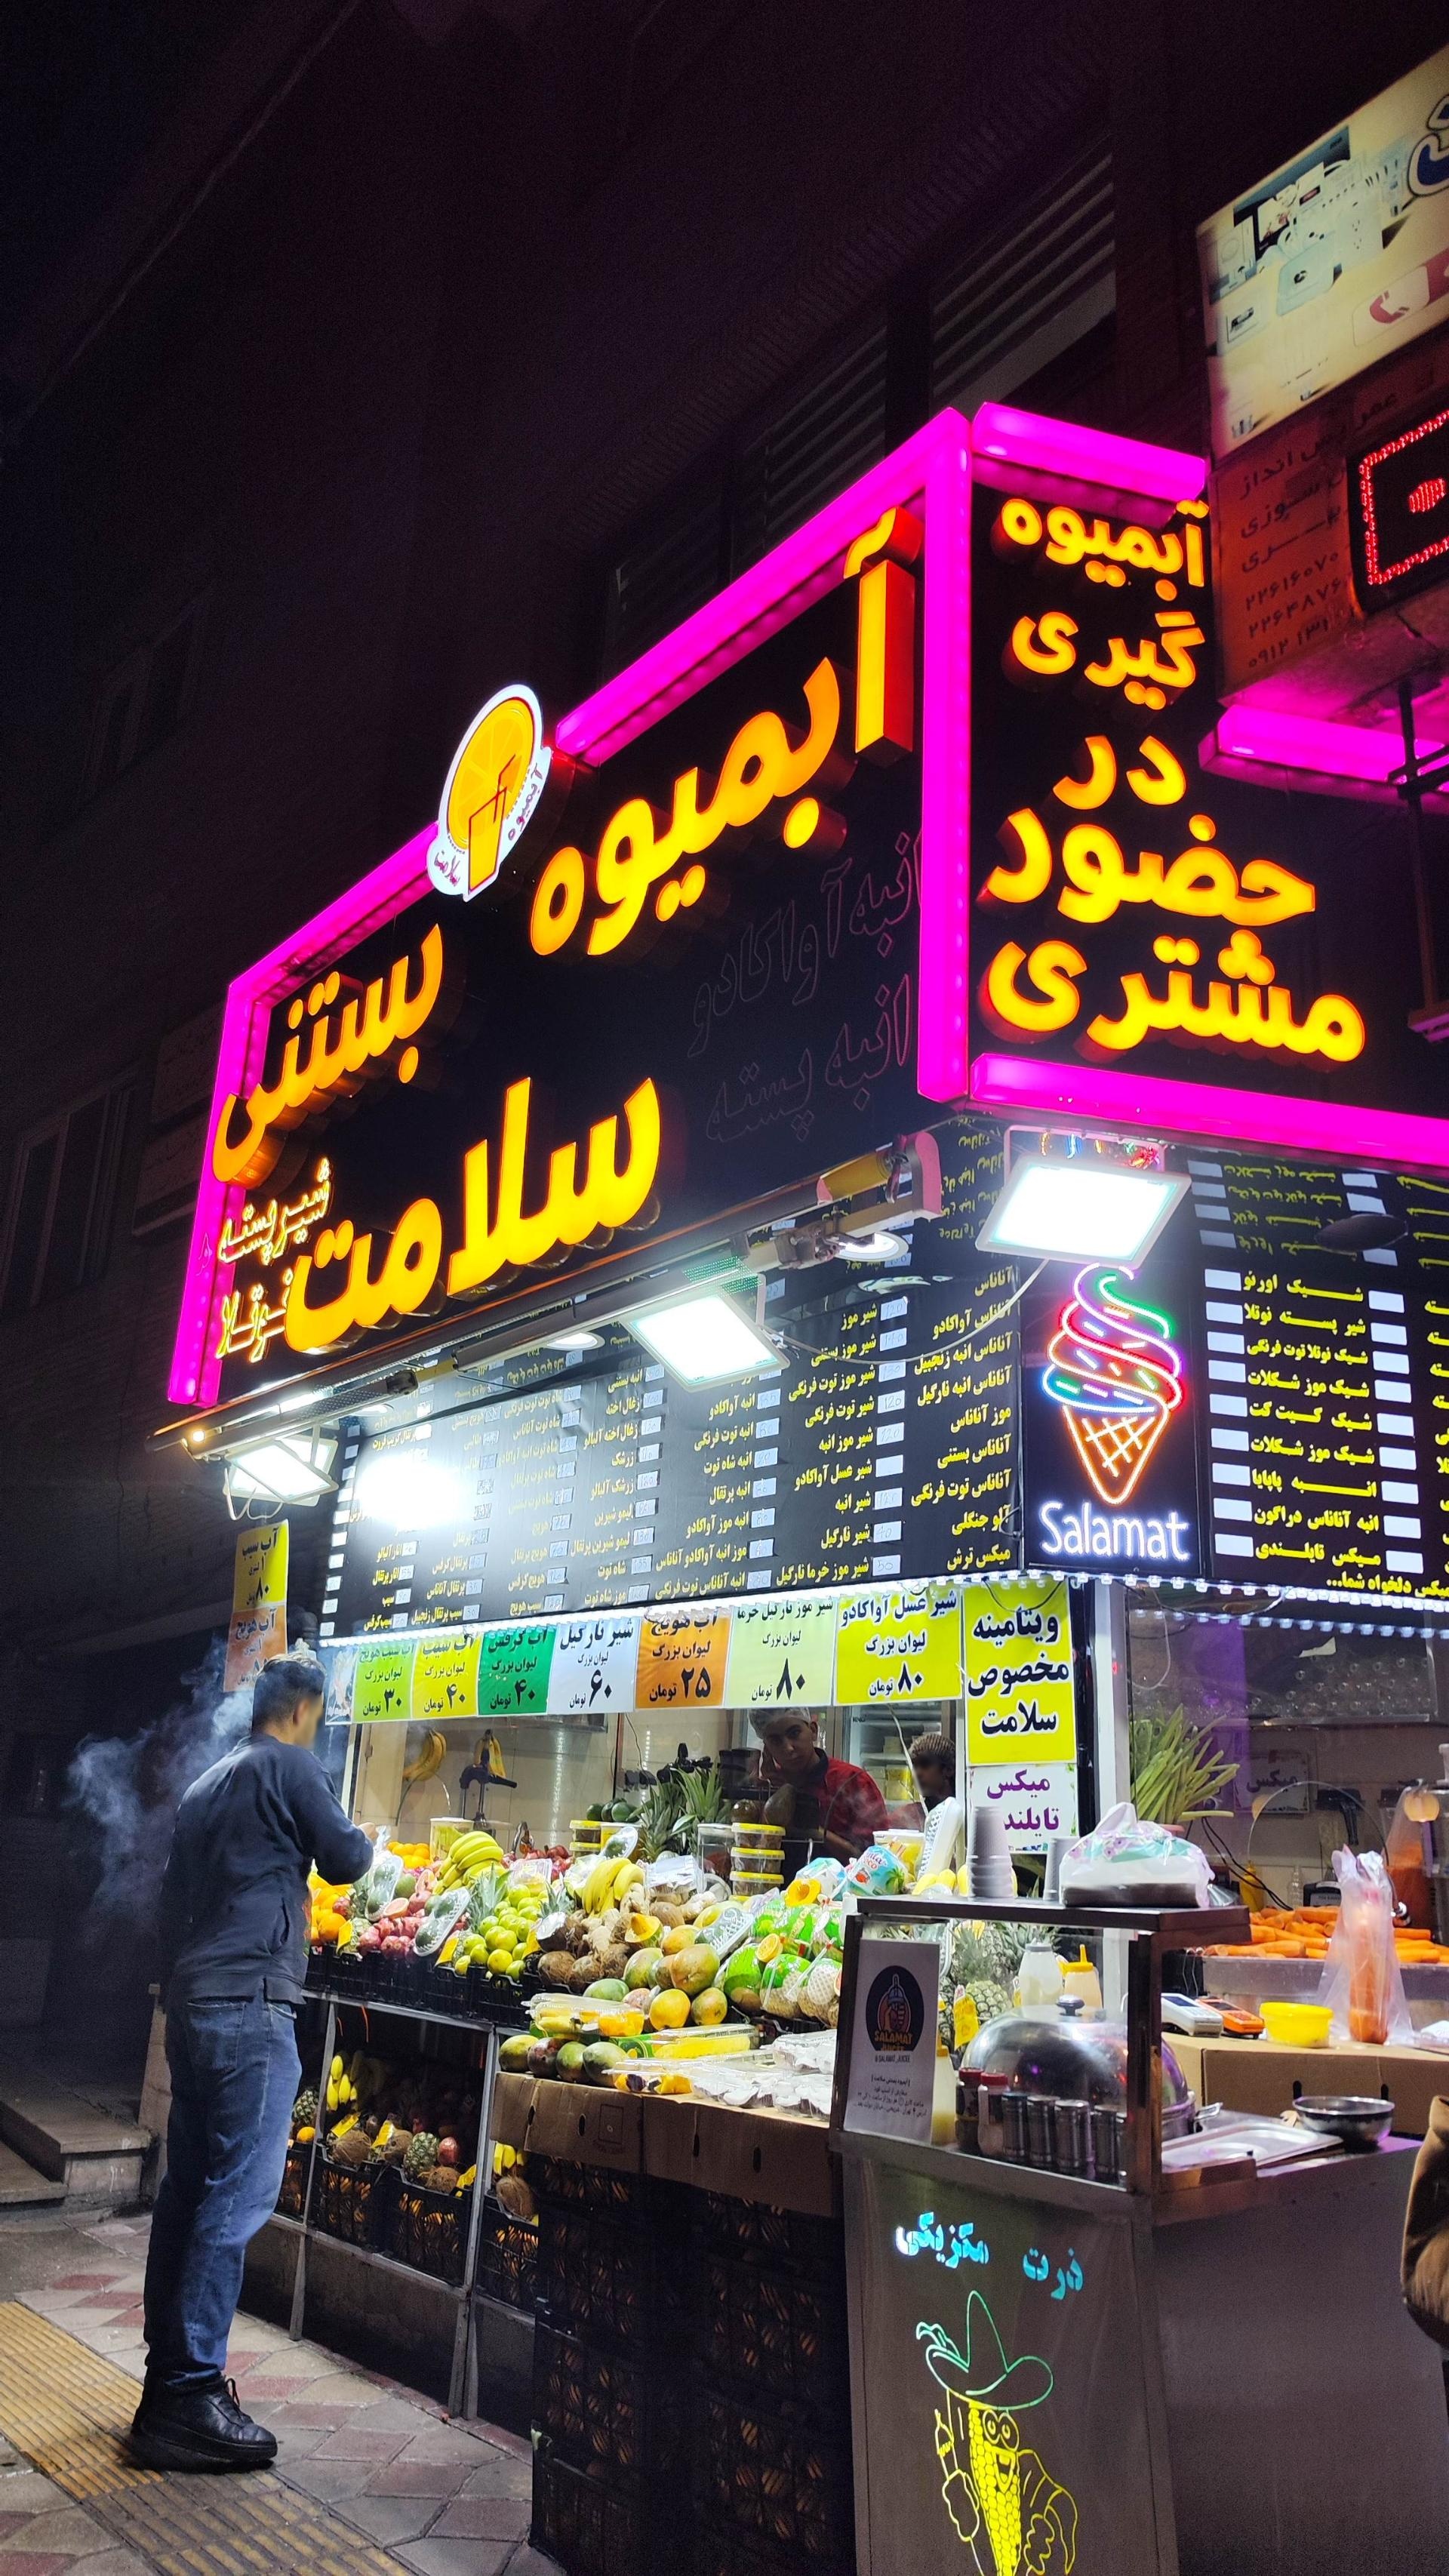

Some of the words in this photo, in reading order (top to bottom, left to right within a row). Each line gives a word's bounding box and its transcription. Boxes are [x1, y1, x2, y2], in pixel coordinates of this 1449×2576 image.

[1000, 498, 1209, 602] آبمیوه
[529, 506, 906, 959] آبمیوه
[1053, 734, 1186, 811] در
[986, 808, 1315, 923] حضور
[988, 928, 1365, 1063] مشتری
[212, 922, 444, 1185] بستنی
[826, 974, 909, 1111] انبه
[707, 1048, 814, 1142] پسته
[273, 1157, 331, 1259] شیر
[283, 1076, 662, 1353] سلامت
[218, 1199, 278, 1265] پسته
[974, 1265, 1013, 1297] آناناس
[1287, 1279, 1363, 1302] شیک
[841, 1313, 859, 1331] موز
[860, 1303, 877, 1325] شیر
[1244, 1303, 1272, 1325] نوتلا
[1279, 1311, 1337, 1335] پسته
[1344, 1318, 1366, 1336] شیر
[1247, 1339, 1281, 1357] فرنگی
[1283, 1344, 1306, 1361] توت
[1307, 1344, 1331, 1364] نوتلا
[1334, 1348, 1368, 1365] شیک
[818, 1375, 838, 1392] توت
[839, 1373, 856, 1390] موز
[857, 1365, 875, 1387] شیر
[952, 1375, 971, 1398] انبه
[973, 1365, 1011, 1396] آناناس
[1247, 1369, 1300, 1390] شکلات
[1304, 1378, 1327, 1396] موز
[788, 1380, 817, 1403] فرنگی
[918, 1379, 949, 1408] نارگیل
[1329, 1379, 1370, 1399] شیک
[804, 1405, 835, 1428] فرنگی
[835, 1400, 855, 1418] توت
[857, 1394, 875, 1417] شیر
[1249, 1401, 1272, 1417] کت
[1275, 1405, 1323, 1423] کیت
[950, 1403, 988, 1434] آناناس
[990, 1406, 1011, 1428] موز
[1331, 1412, 1373, 1432] شیک
[694, 1429, 719, 1451] فرنگی
[721, 1426, 738, 1441] توت
[739, 1421, 754, 1438] انبه
[856, 1426, 873, 1450] شیر
[819, 1433, 835, 1453] انبه
[836, 1436, 854, 1452] موز
[1251, 1436, 1304, 1457] شکلات
[1308, 1444, 1331, 1463] موز
[1334, 1445, 1375, 1466] شیک
[794, 1464, 829, 1491] آواکادو
[830, 1466, 853, 1485] عسل
[854, 1458, 872, 1482] شیر
[709, 1484, 734, 1506] پرتقال
[736, 1480, 751, 1497] انبه
[947, 1478, 969, 1499] توت
[972, 1469, 1011, 1499] آناناس
[1291, 1476, 1377, 1498] انبه
[835, 1494, 852, 1512] انبه
[854, 1490, 871, 1513] شیر
[911, 1483, 945, 1508] فرنگی
[952, 1512, 989, 1537] جنگلی
[1039, 1500, 1191, 1562] Salamat
[1307, 1510, 1352, 1530] آناناس
[1357, 1514, 1380, 1534] انبه
[261, 1527, 278, 1555] آب
[1255, 1541, 1324, 1563] تایلندی
[947, 1547, 973, 1571] ترش
[976, 1543, 1011, 1568] میکس
[1331, 1547, 1381, 1568] میکس
[256, 1577, 269, 1601] ۸۰
[1367, 1574, 1412, 1594] دلخواه
[816, 1596, 833, 1616] شیر
[841, 1594, 889, 1627] آواکادو
[894, 1596, 926, 1620] عسل
[930, 1590, 957, 1617] شیر
[608, 1618, 633, 1647] شیر
[973, 1606, 1059, 1646] ویتامینه
[422, 1639, 451, 1659] سیب
[683, 1640, 711, 1658] لیوان
[783, 1630, 801, 1646] لیوان
[898, 1632, 926, 1654] لیوان
[516, 1657, 537, 1673] لیوان
[594, 1649, 608, 1665] لیوان
[385, 1667, 402, 1682] لیوان
[447, 1662, 465, 1678] لیوان
[777, 1658, 805, 1700] ۸۰
[898, 1663, 923, 1693] ۸۰
[968, 1652, 1069, 1697] مخصوص
[514, 1679, 535, 1707] ۴۰
[589, 1670, 612, 1707] ۶۰
[649, 1684, 676, 1701] تومان
[681, 1667, 711, 1698] ۲۵
[751, 1685, 773, 1701] تومان
[869, 1679, 893, 1697] تومان
[384, 1688, 401, 1713] ۳۰
[423, 1697, 444, 1713] تومان
[446, 1683, 465, 1710] ۴۰
[490, 1694, 511, 1710] تومان
[569, 1694, 586, 1708] تومان
[363, 1702, 381, 1716] تومان
[981, 1700, 1057, 1735] سلامت
[987, 1769, 1051, 1799] میکس
[1004, 1807, 1060, 1837] تایلند
[874, 2030, 912, 2045] SALAMAT
[896, 2211, 989, 2268] مکزیکی
[1023, 2247, 1084, 2301] ذرت
